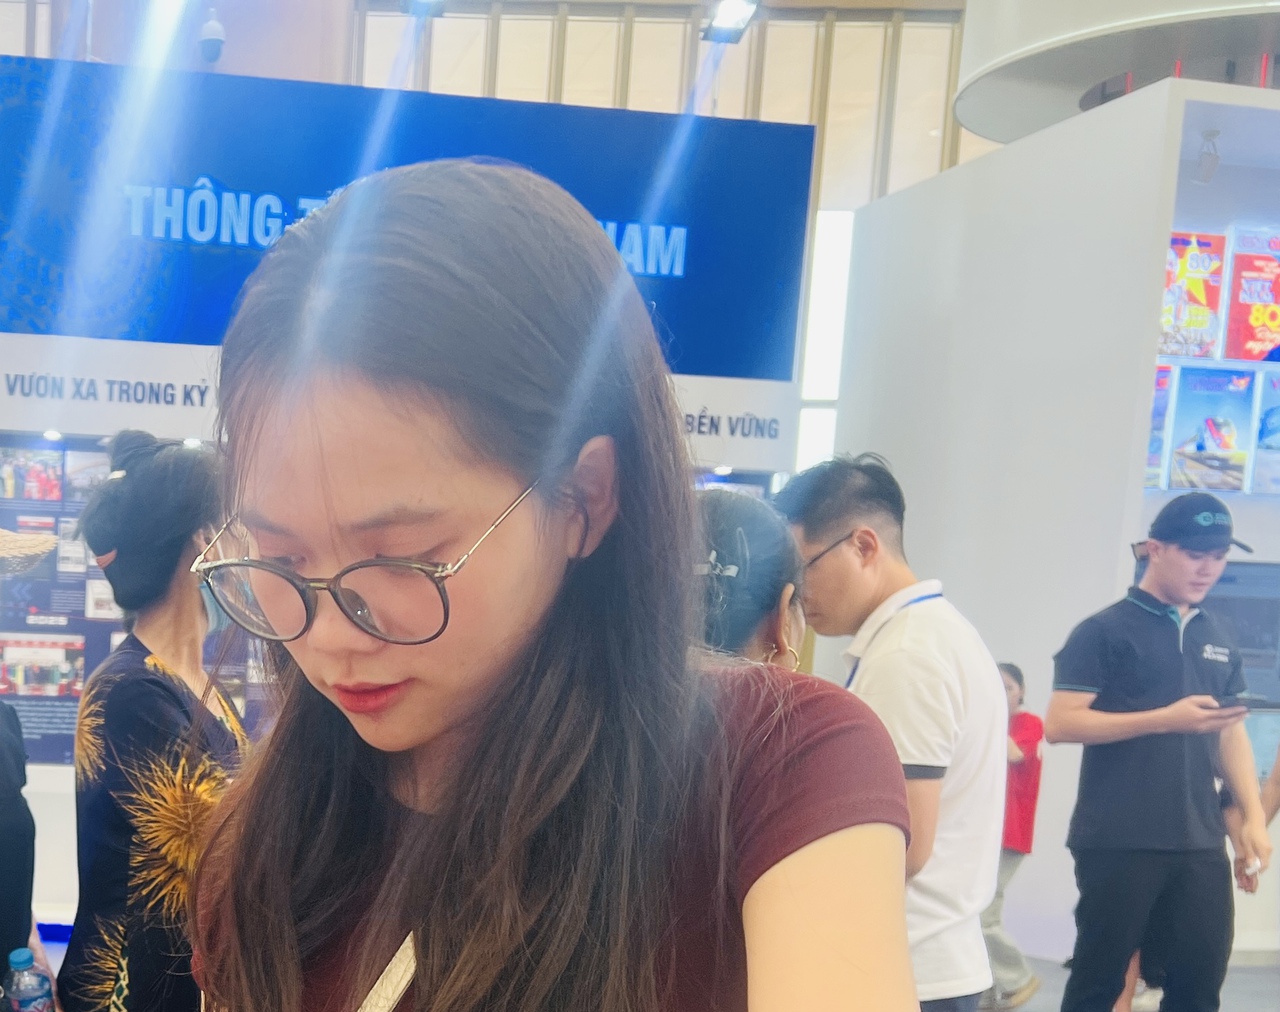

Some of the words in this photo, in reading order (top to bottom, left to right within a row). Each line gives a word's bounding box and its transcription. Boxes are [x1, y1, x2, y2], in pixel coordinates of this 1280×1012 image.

[122, 175, 284, 248] THÔNG
[4, 372, 65, 399] VƯƠN
[72, 377, 98, 400] XA
[105, 379, 176, 405] TRONG
